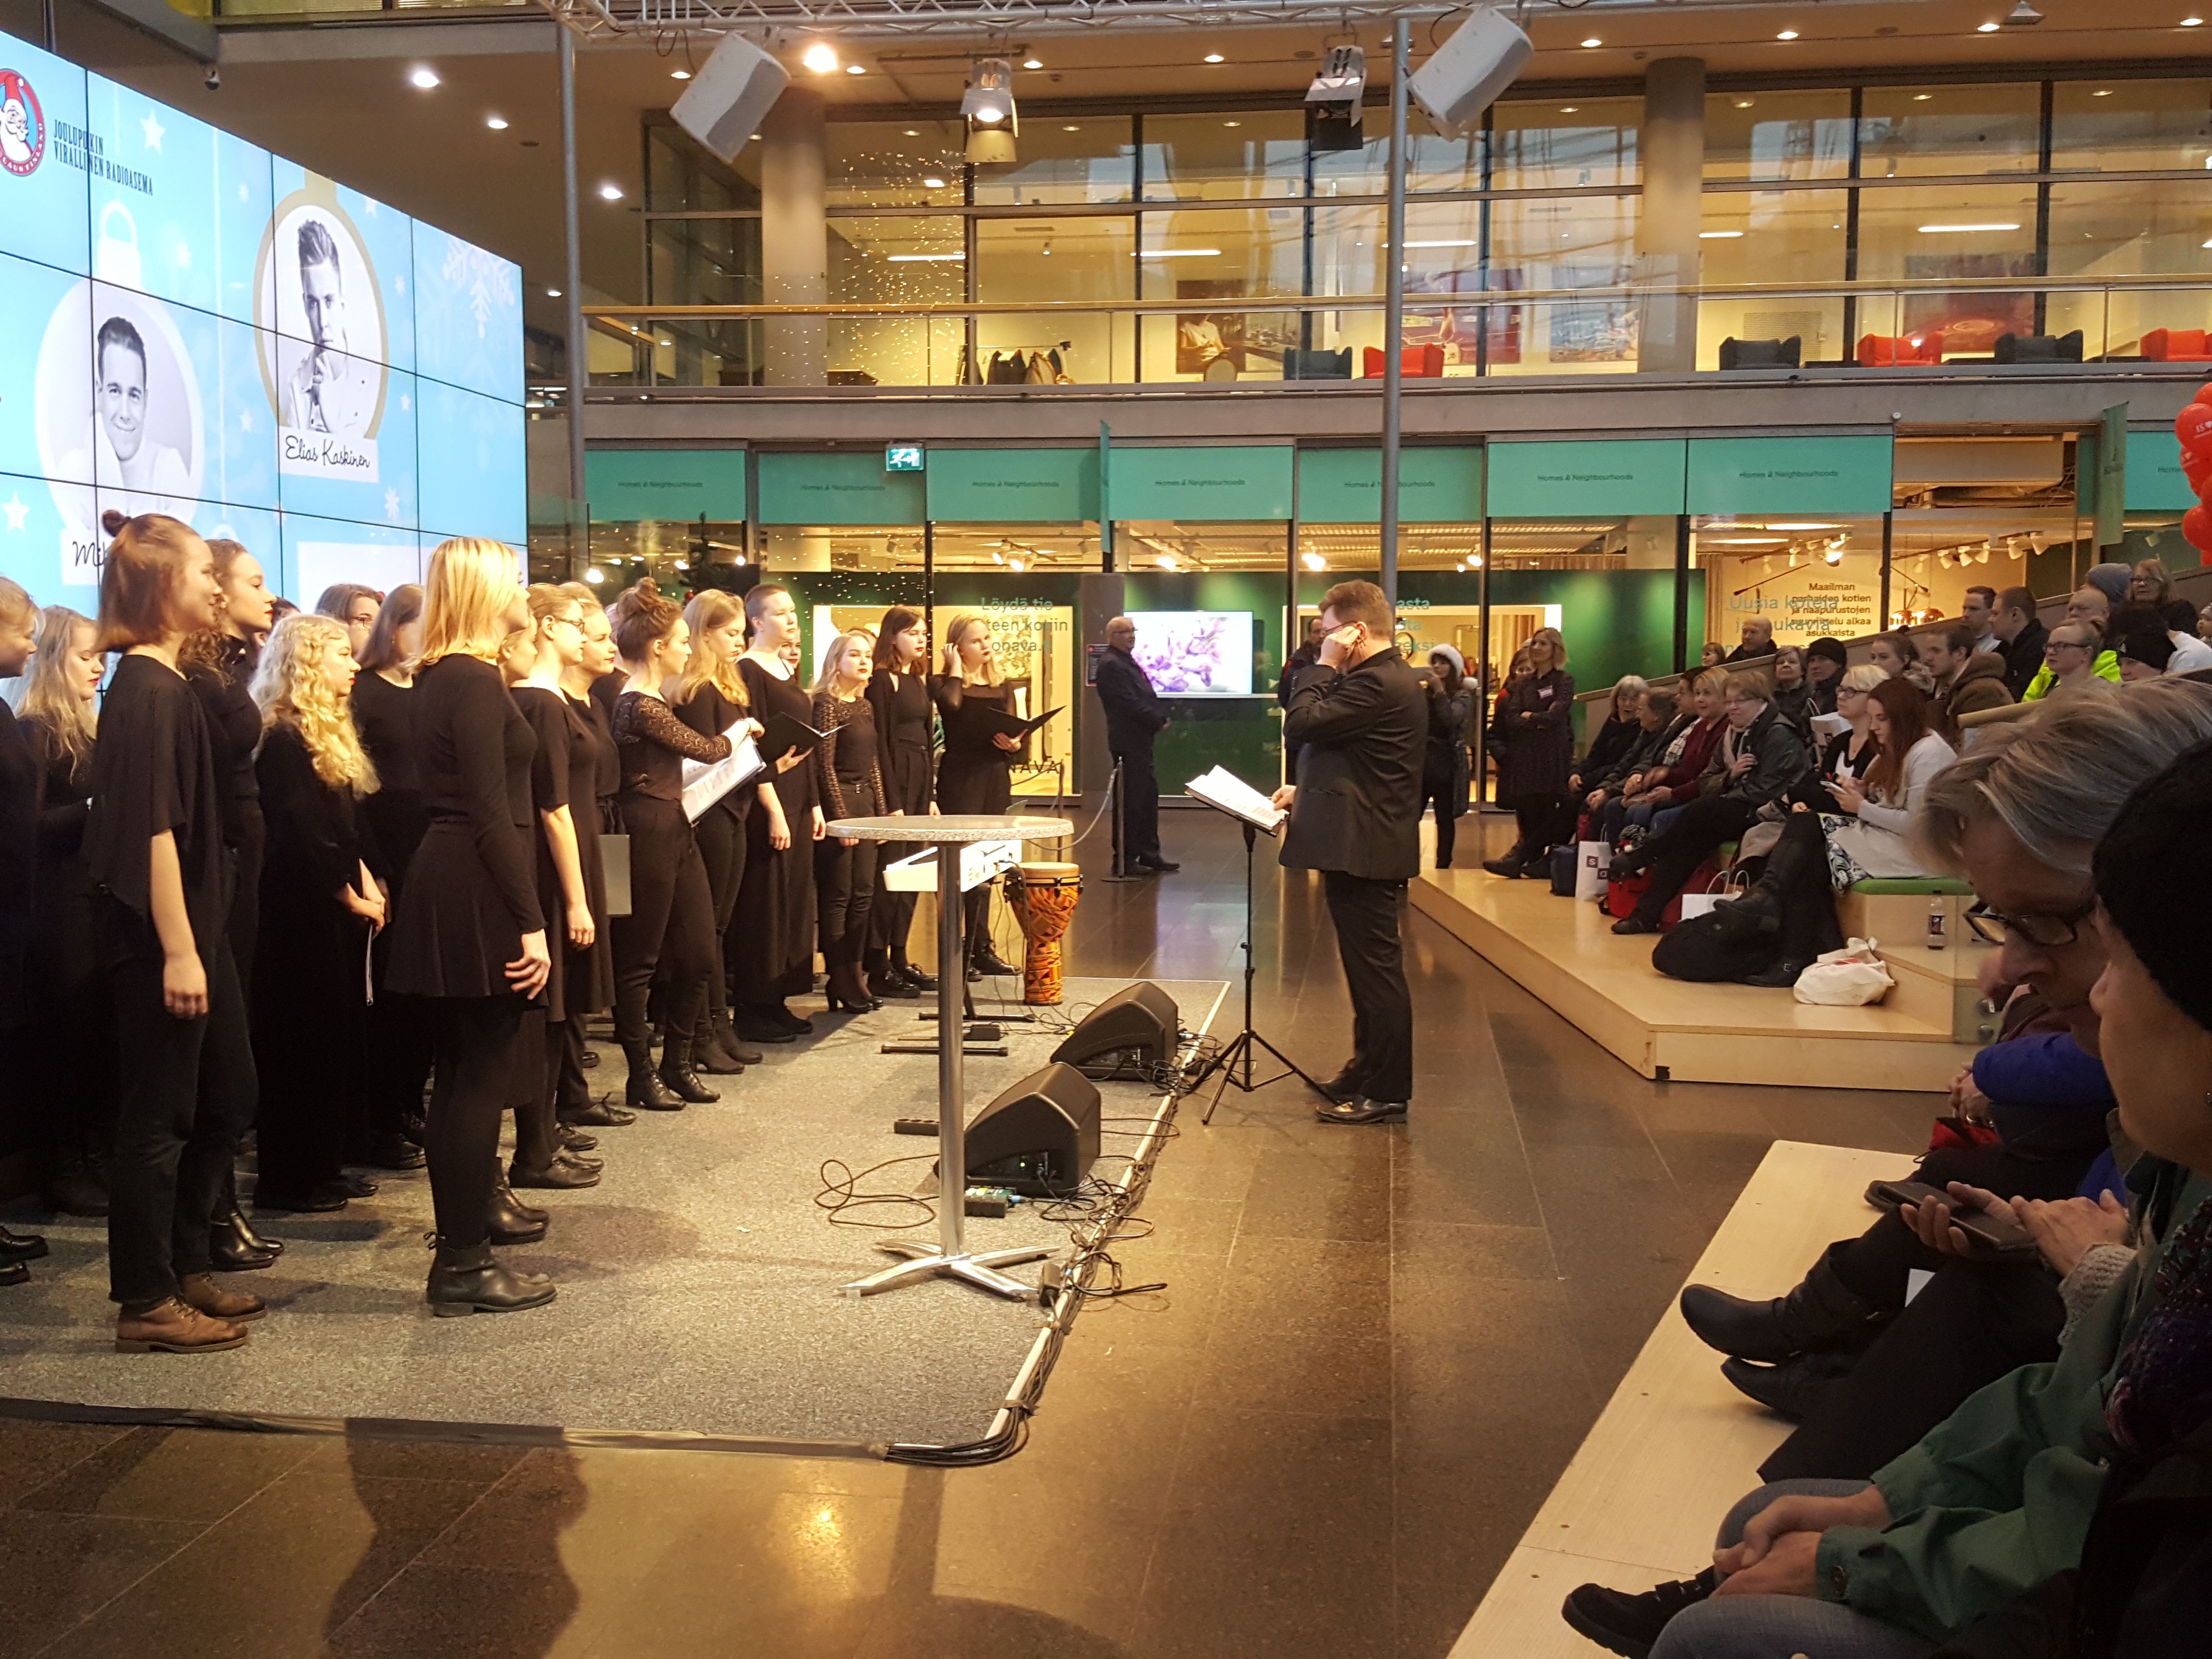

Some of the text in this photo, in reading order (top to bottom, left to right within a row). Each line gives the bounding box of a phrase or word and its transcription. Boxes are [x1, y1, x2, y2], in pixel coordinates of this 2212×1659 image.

[54, 119, 103, 155] JOULUPUKIN
[54, 140, 153, 195] VIRALLINEN RADIOASEMA
[285, 435, 370, 467] Elias Kaskinen
[982, 597, 1053, 612] Löydä tie
[1396, 597, 1430, 610] asta
[1730, 595, 1778, 610] Uusia
[1842, 594, 1872, 602] kotien
[1803, 605, 1871, 615] naapurustojen
[986, 618, 1068, 631] teen kotiin
[1774, 617, 1831, 631] ukavia
[1806, 629, 1856, 637] asukkaista
